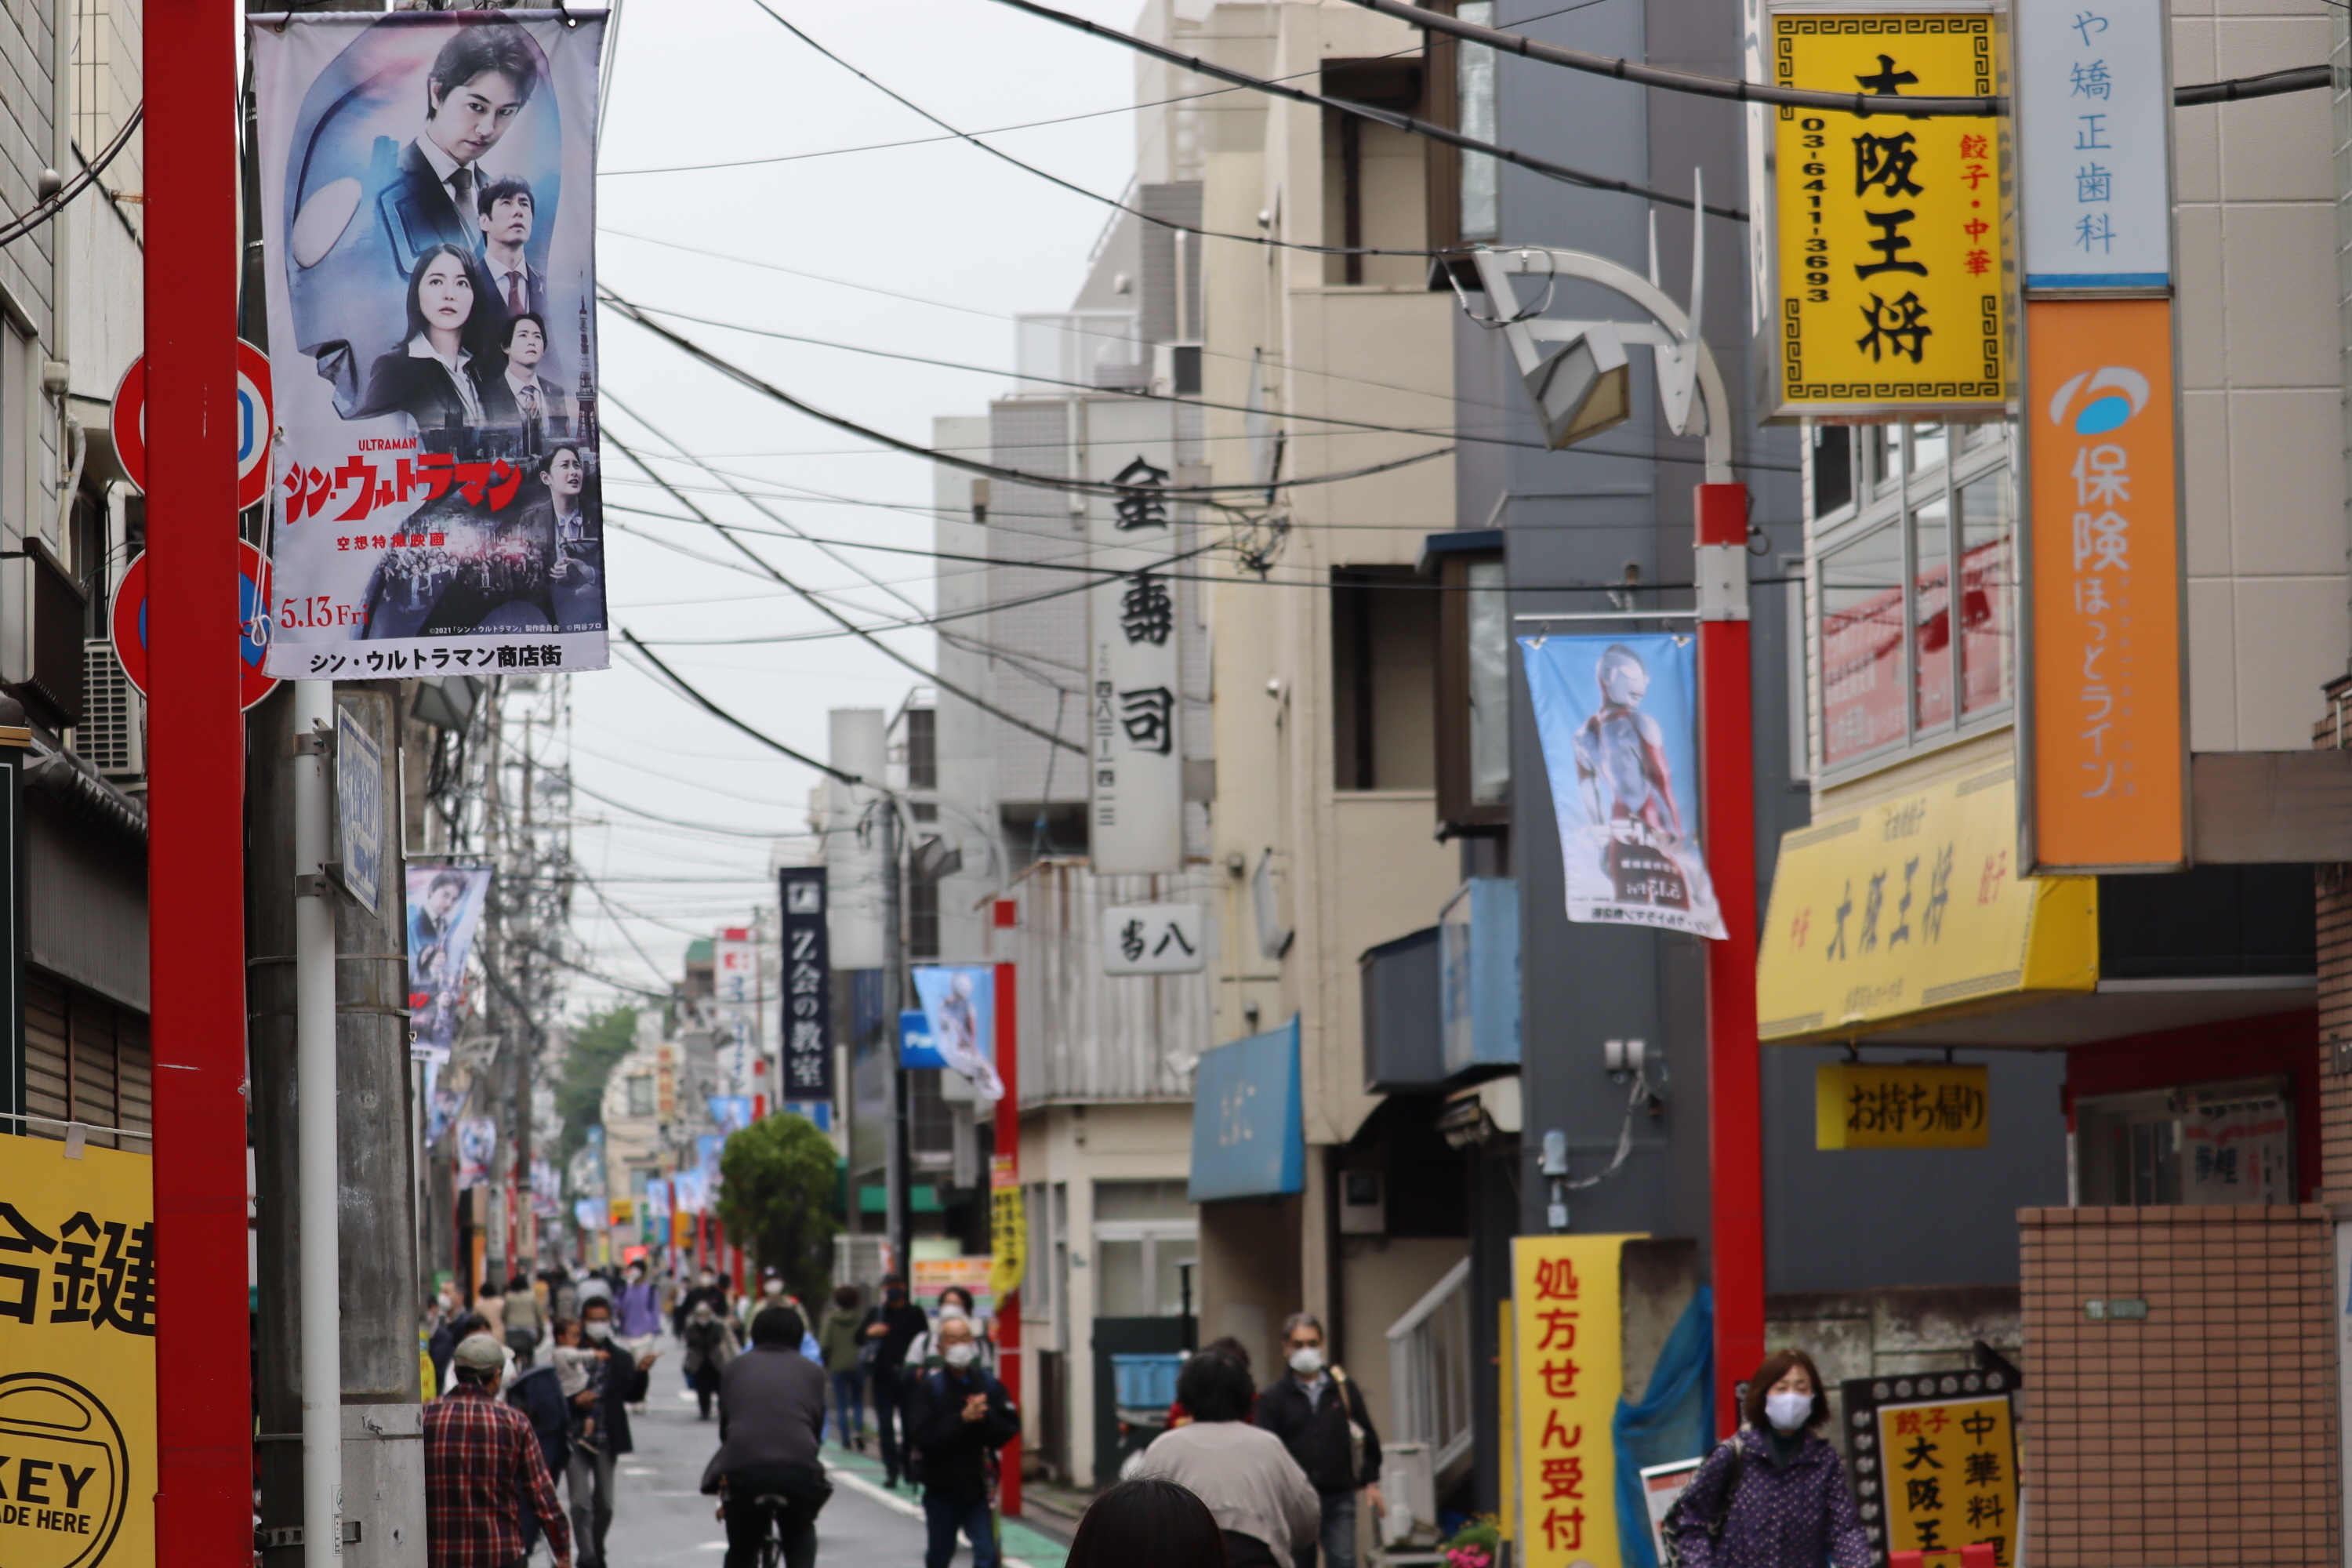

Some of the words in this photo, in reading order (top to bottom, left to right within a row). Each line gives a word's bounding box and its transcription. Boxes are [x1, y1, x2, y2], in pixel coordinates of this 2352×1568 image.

[2069, 10, 2117, 255] や矯正歯科
[1800, 118, 1830, 303] 03-6411-3693
[1853, 54, 1933, 365] 大阪王将
[358, 437, 417, 452] ULTRAMAN
[282, 453, 522, 524] シン・ウルトラマン
[337, 532, 445, 551] 空想特撮映画
[281, 595, 332, 629] 5.13
[336, 604, 369, 626] Fri
[2071, 444, 2131, 800] 保険ほっとライン
[310, 644, 563, 673] シン・ウルトラマン商店街
[791, 928, 823, 1087] Z会の教室
[1846, 1082, 1984, 1134] お持ち帰り
[1534, 1256, 1586, 1552] 処方せん受付
[1893, 1407, 1951, 1436] 餃子
[0, 1504, 31, 1526] DE
[37, 1508, 92, 1535] HERE
[1900, 1436, 1947, 1568] 大阪王
